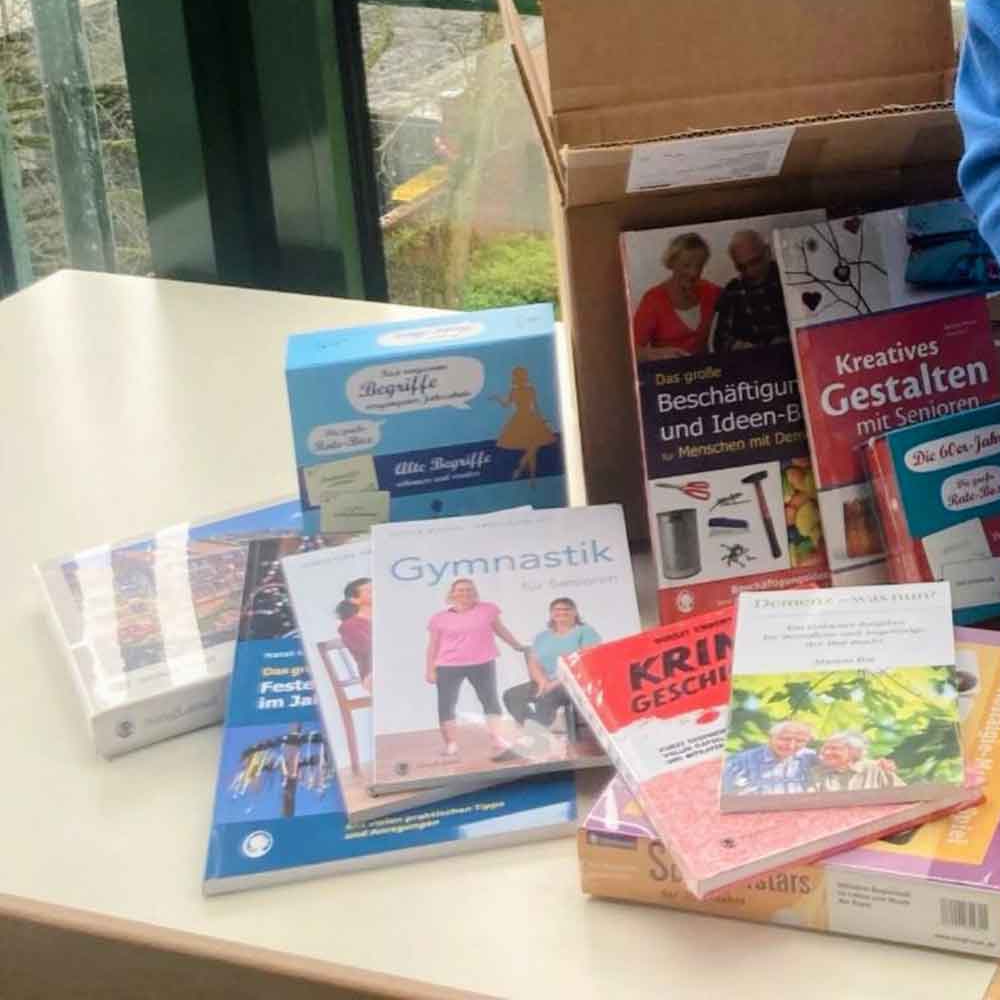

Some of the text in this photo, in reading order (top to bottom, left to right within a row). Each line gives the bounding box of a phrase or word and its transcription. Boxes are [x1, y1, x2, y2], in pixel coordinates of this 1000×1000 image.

[835, 340, 939, 376] Kreatives
[359, 372, 439, 401] Begriffe
[656, 373, 680, 386] Das
[821, 360, 989, 416] Gestalten
[856, 396, 980, 436] mit Senioren
[661, 416, 704, 441] und
[678, 439, 745, 458] Menschen
[750, 435, 770, 448] mit
[912, 450, 935, 467] Die
[429, 450, 492, 473] Begriffe
[390, 539, 614, 588] Gymnastik
[754, 597, 833, 609] Demenz
[258, 696, 285, 710] im
